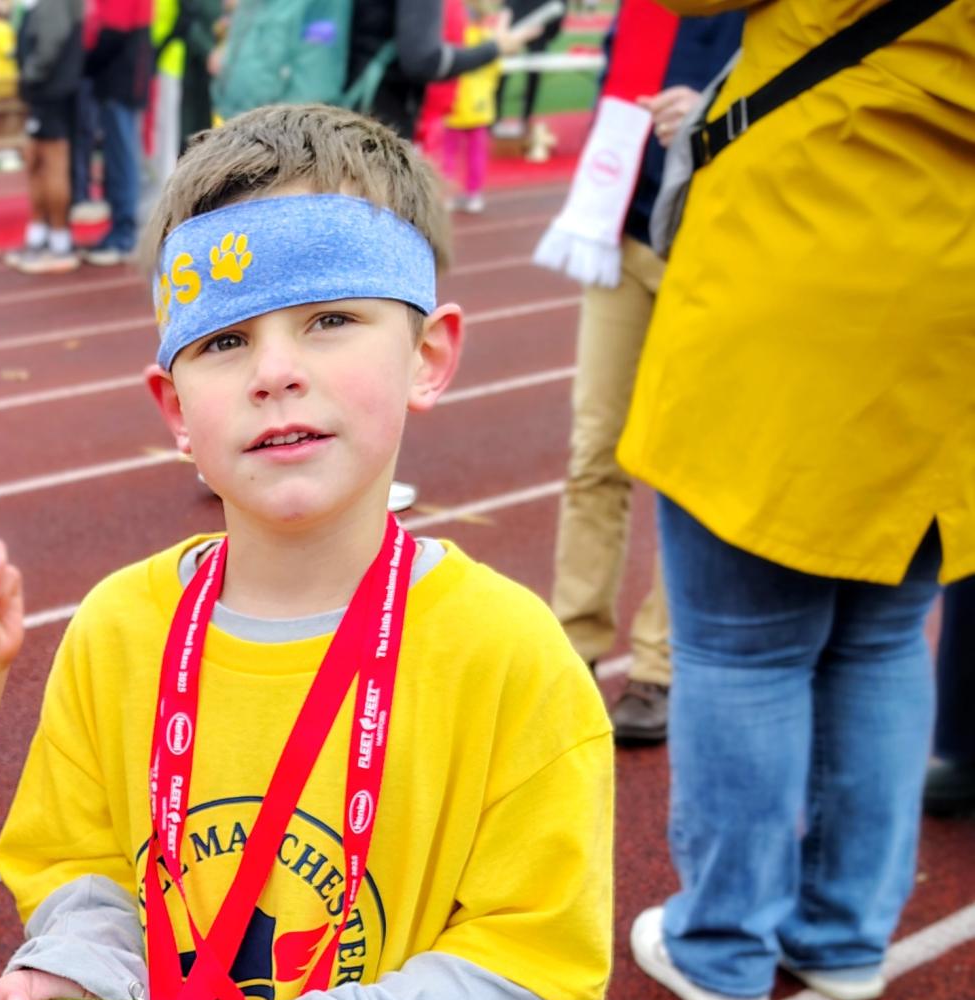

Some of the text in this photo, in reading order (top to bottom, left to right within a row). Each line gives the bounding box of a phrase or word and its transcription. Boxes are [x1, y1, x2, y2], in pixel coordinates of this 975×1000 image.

[389, 545, 402, 567] Road
[191, 577, 214, 622] Manchester
[382, 567, 398, 611] Manchester
[185, 623, 198, 646] Road
[378, 612, 392, 638] Little
[180, 647, 193, 670] Race
[375, 640, 388, 658] The
[177, 671, 188, 693] 2025
[173, 715, 185, 753] Henkel
[358, 687, 381, 769] FLEET FEET
[167, 775, 184, 851] FLEET FEET
[353, 792, 367, 832] Henkel
[188, 821, 366, 987] MACHESTER
